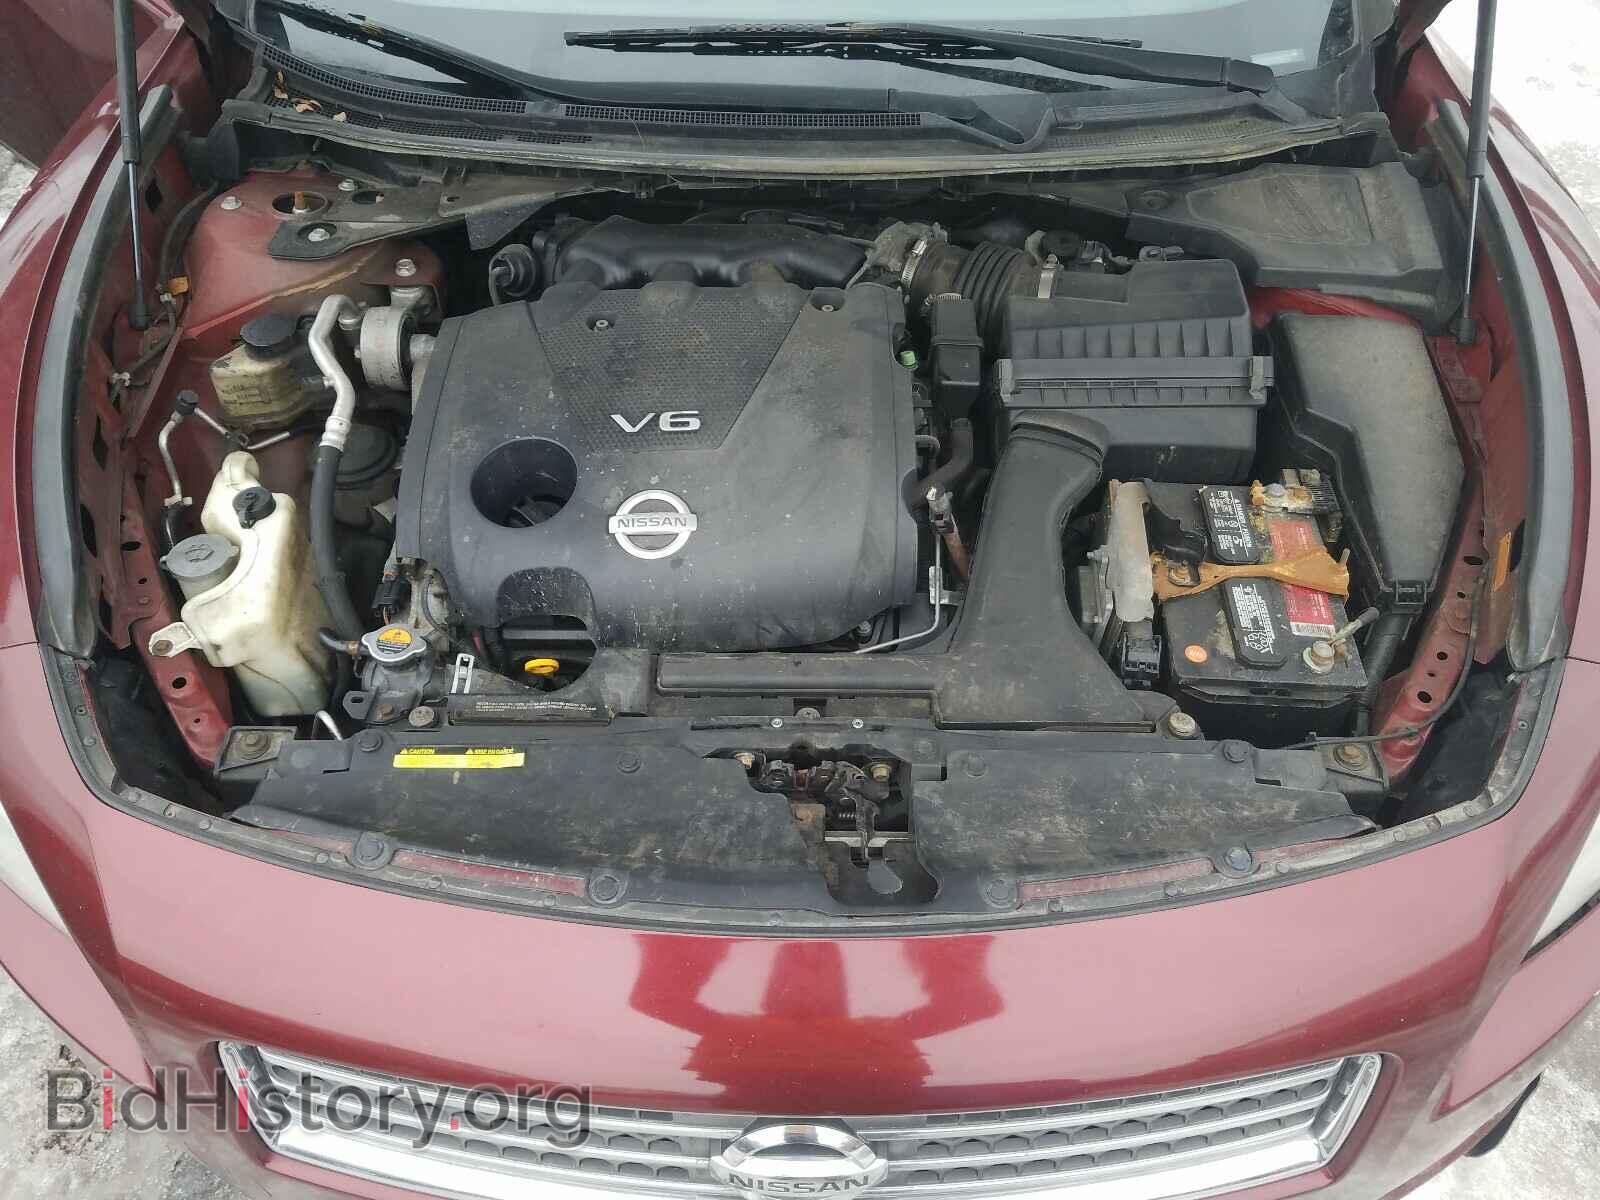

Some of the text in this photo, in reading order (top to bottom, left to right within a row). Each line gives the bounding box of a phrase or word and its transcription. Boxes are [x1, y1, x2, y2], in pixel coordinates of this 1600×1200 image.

[610, 410, 700, 432] V6
[617, 516, 687, 528] NISSAN
[729, 1173, 869, 1193] NISSAN
